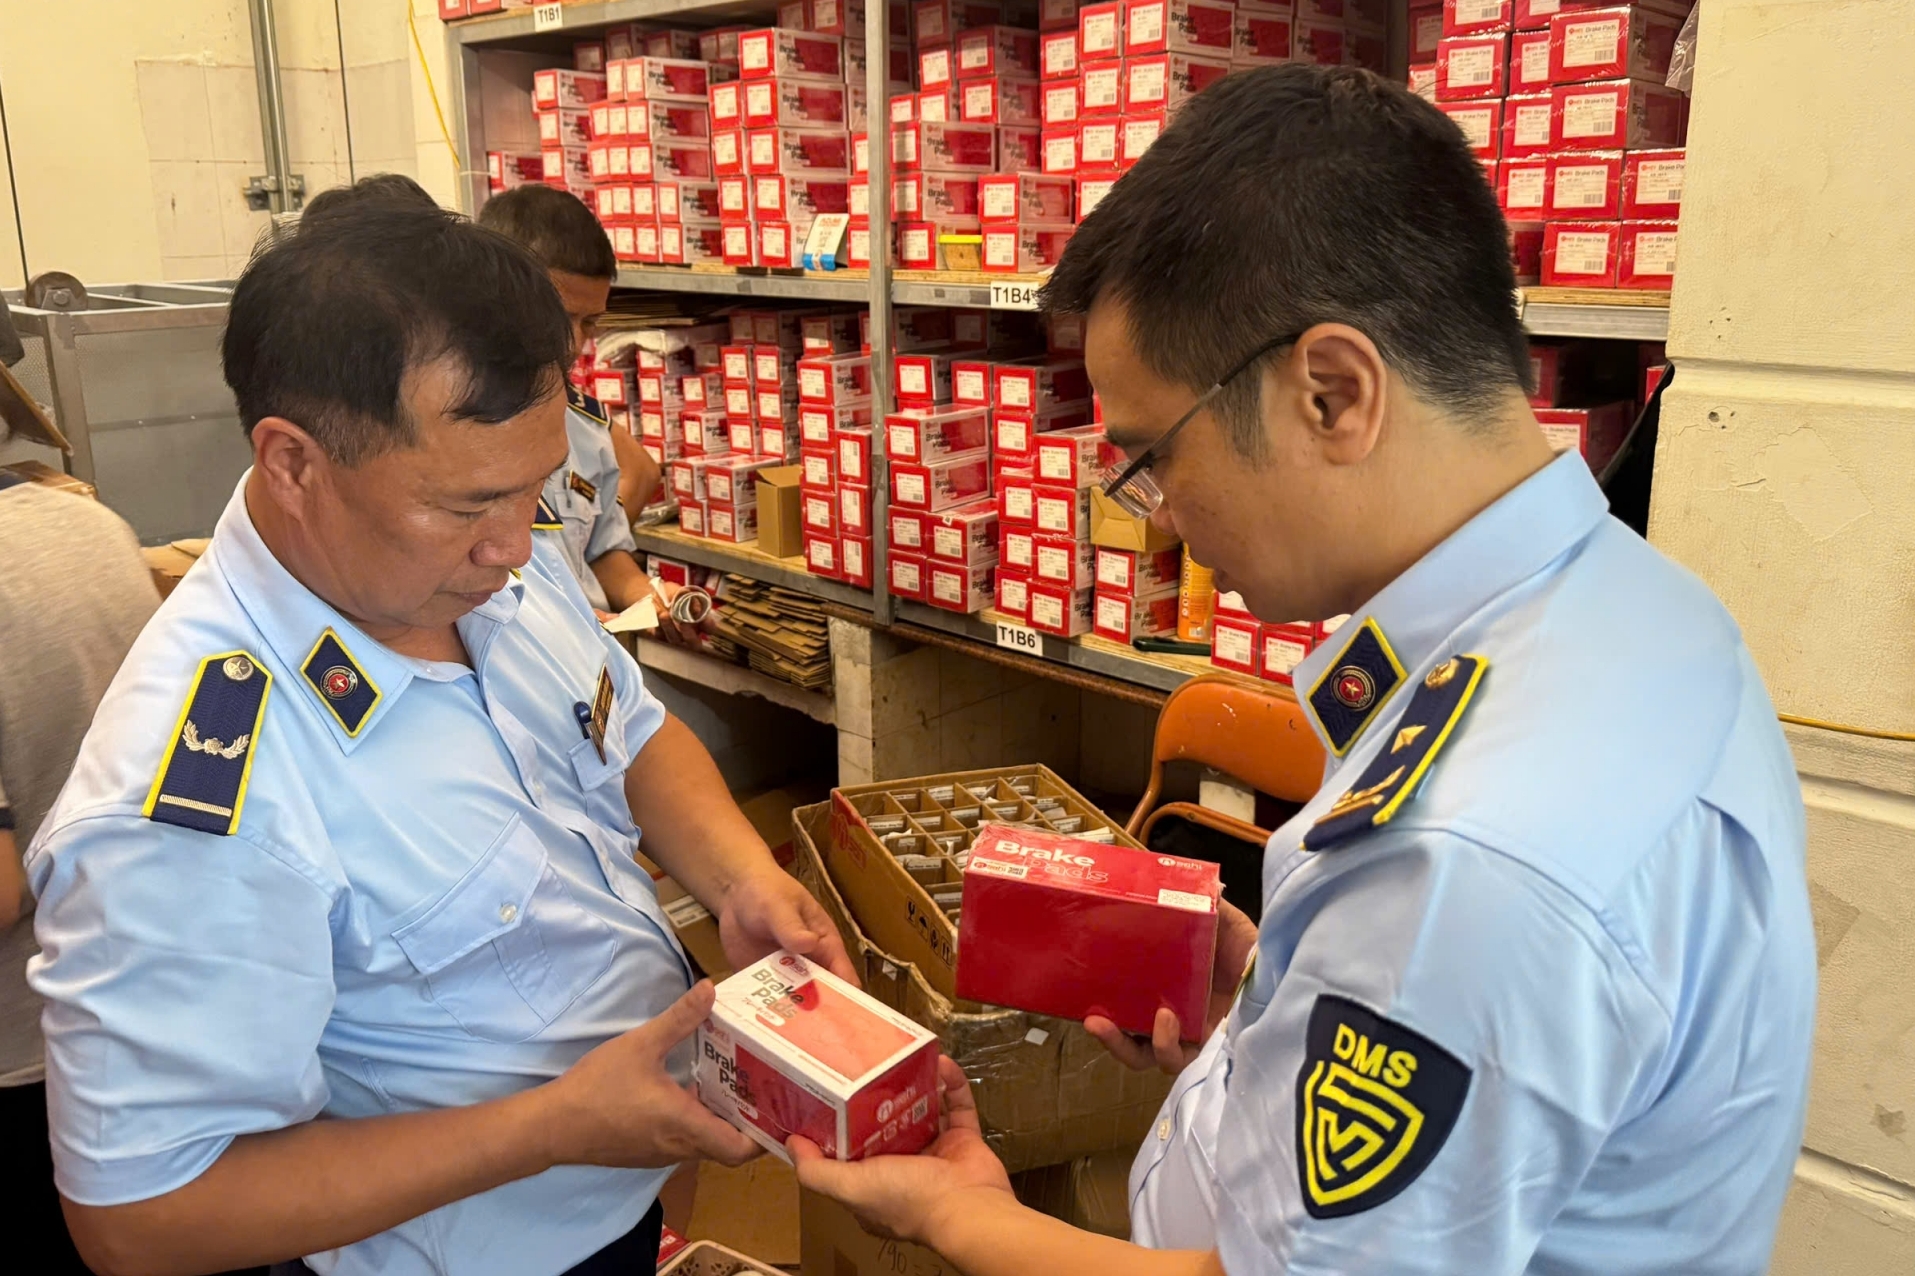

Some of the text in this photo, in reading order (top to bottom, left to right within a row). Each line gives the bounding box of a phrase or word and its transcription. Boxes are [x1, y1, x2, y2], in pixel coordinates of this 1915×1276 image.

[538, 7, 560, 23] T1B1
[992, 286, 1031, 304] T1B4
[999, 625, 1036, 649] T1B6
[995, 840, 1096, 867] Brake
[751, 968, 804, 1004] Brake
[751, 987, 797, 1018] Pads
[704, 1040, 749, 1083] Brake
[1333, 1022, 1418, 1088] DMS
[719, 1067, 757, 1107] Pads
